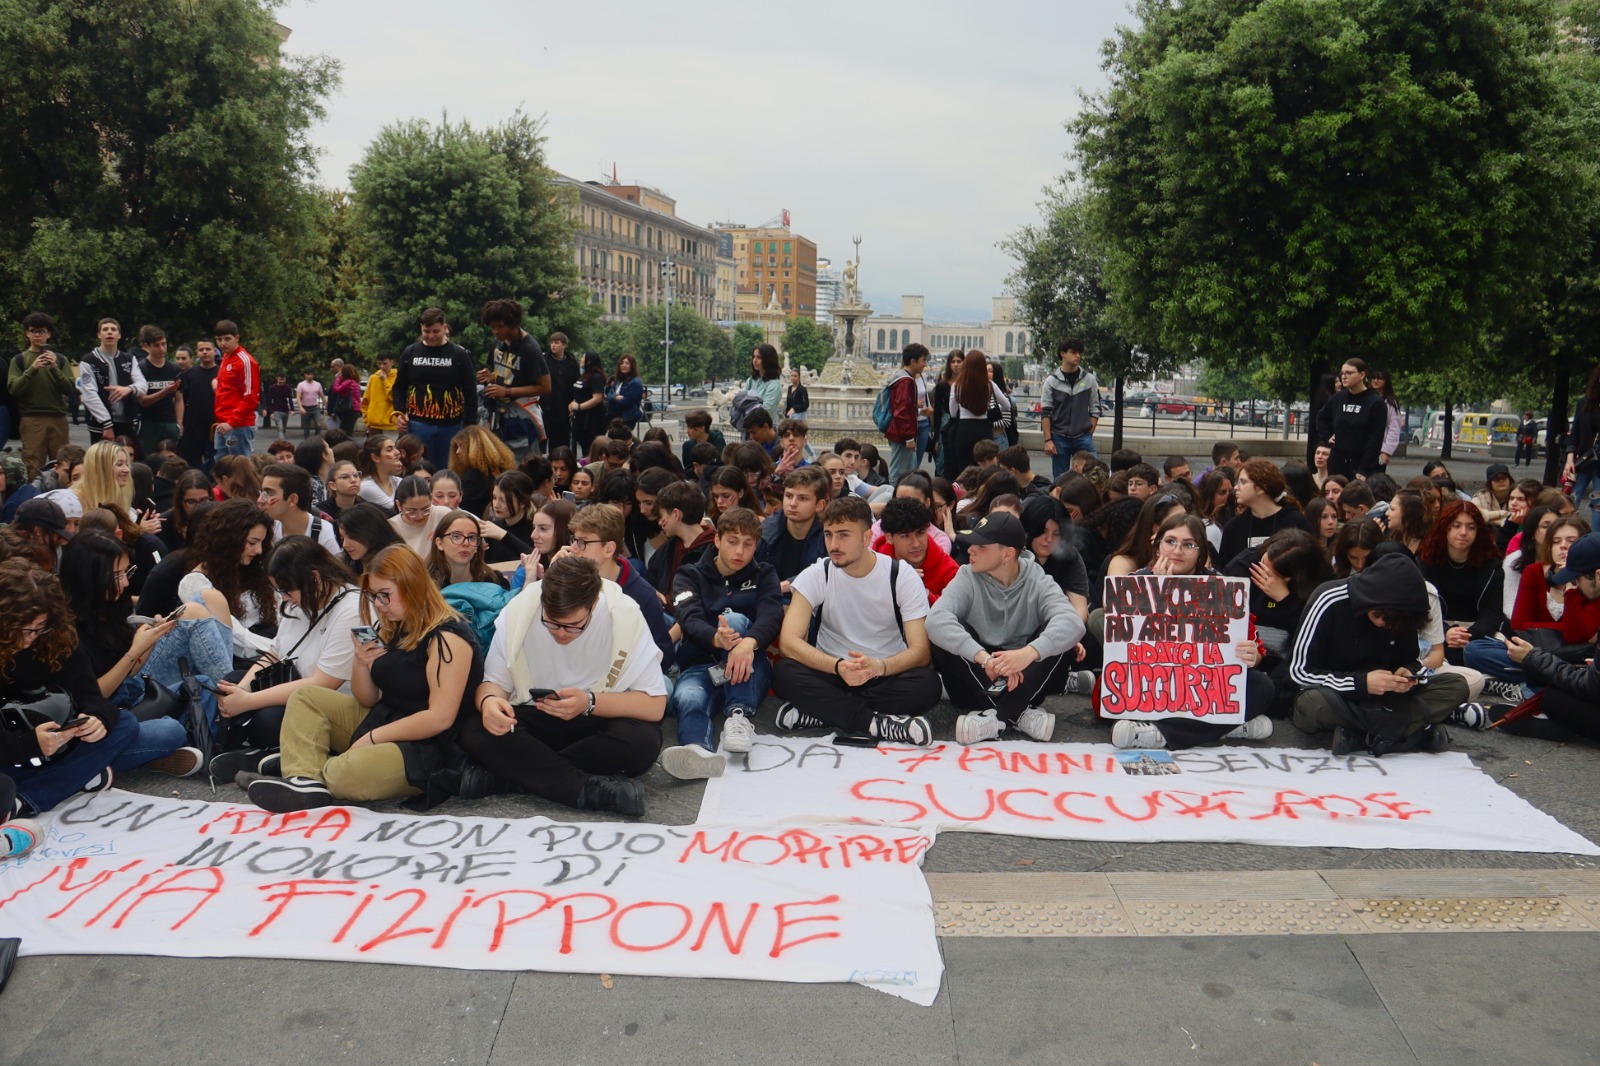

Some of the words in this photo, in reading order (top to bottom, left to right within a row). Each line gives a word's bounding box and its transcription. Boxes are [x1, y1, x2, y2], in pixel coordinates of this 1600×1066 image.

[413, 357, 452, 367] REALTEAM
[1342, 403, 1362, 414] VANS
[1104, 577, 1152, 615] NON
[1138, 615, 1231, 643] ASPETTARE
[1127, 642, 1198, 665] RIDATECI
[1203, 642, 1224, 665] LA
[1102, 661, 1242, 717] SUCCURSALE
[742, 742, 844, 773] DA
[958, 746, 1116, 774] ANNI
[1173, 752, 1388, 777] SENZA
[358, 820, 511, 849] NON
[678, 829, 931, 868] MORIRE
[533, 853, 628, 887] DI
